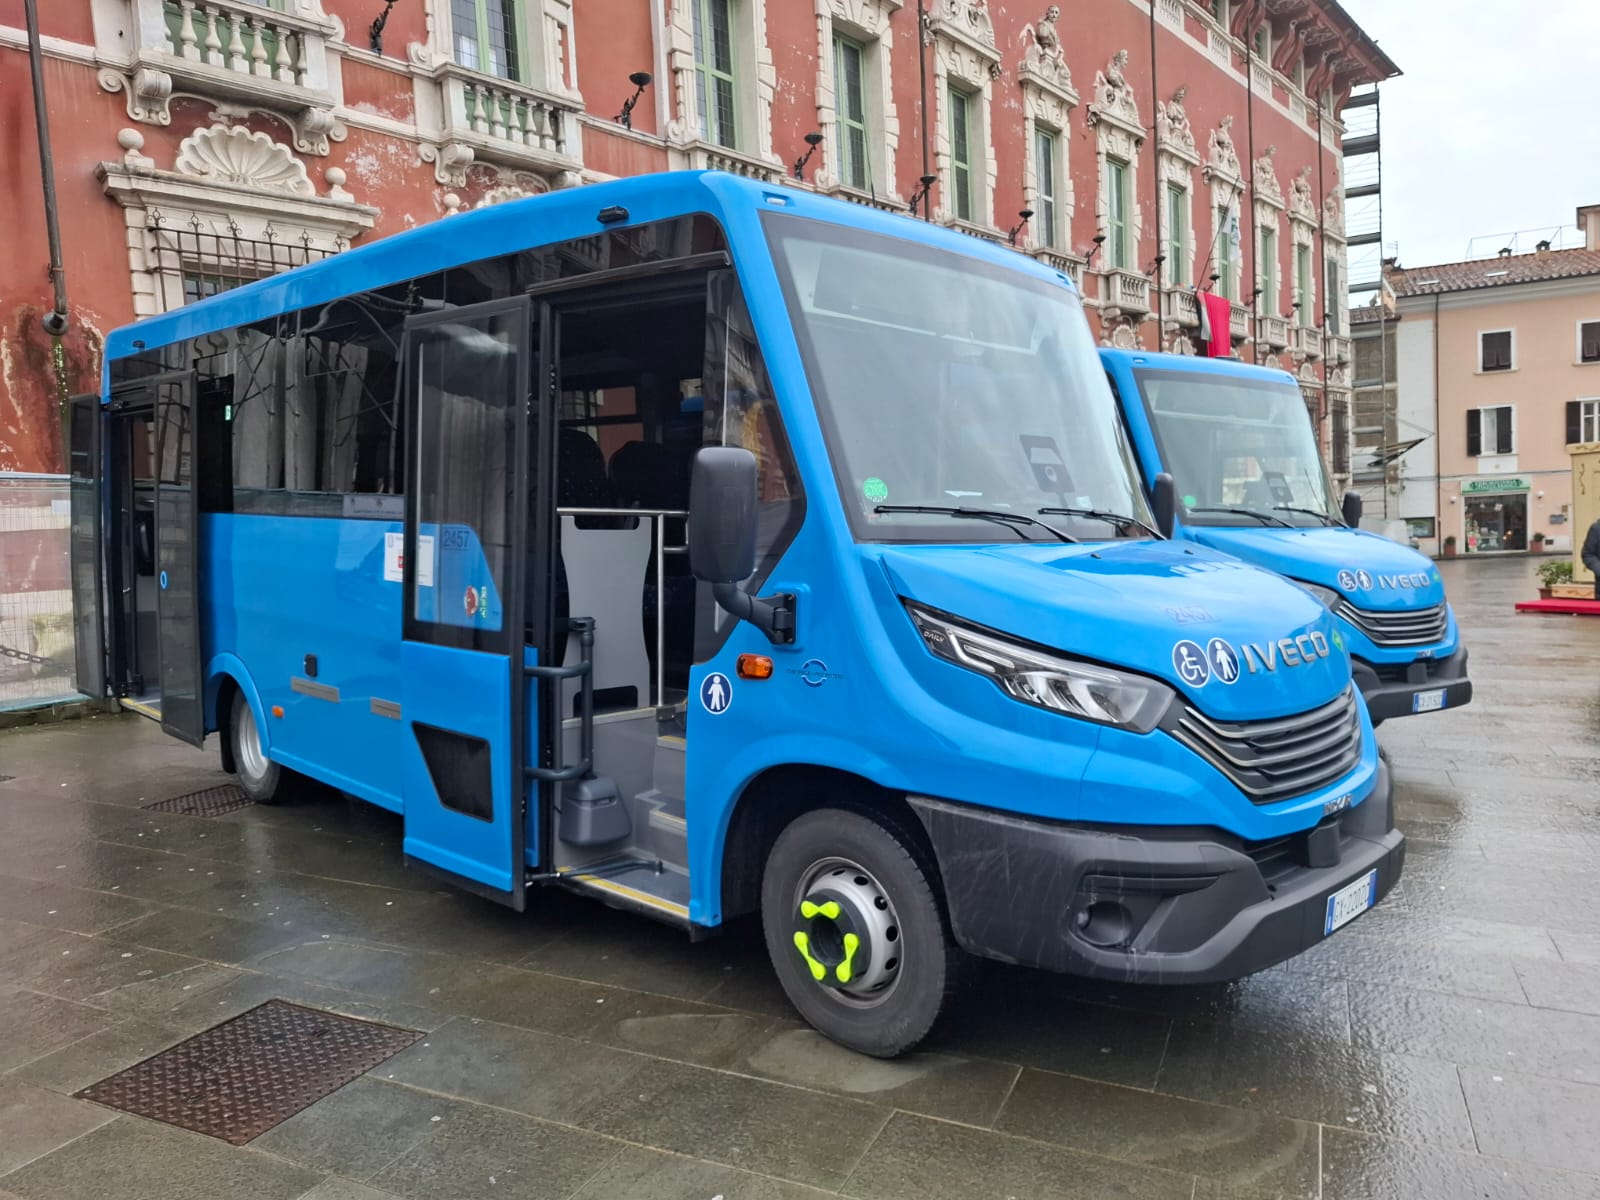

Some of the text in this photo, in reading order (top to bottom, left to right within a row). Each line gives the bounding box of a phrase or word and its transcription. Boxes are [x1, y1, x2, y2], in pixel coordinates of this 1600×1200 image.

[442, 530, 470, 548] 2457
[1378, 572, 1430, 589] IVECO
[924, 631, 945, 643] DAILY
[1241, 631, 1329, 673] IVECO
